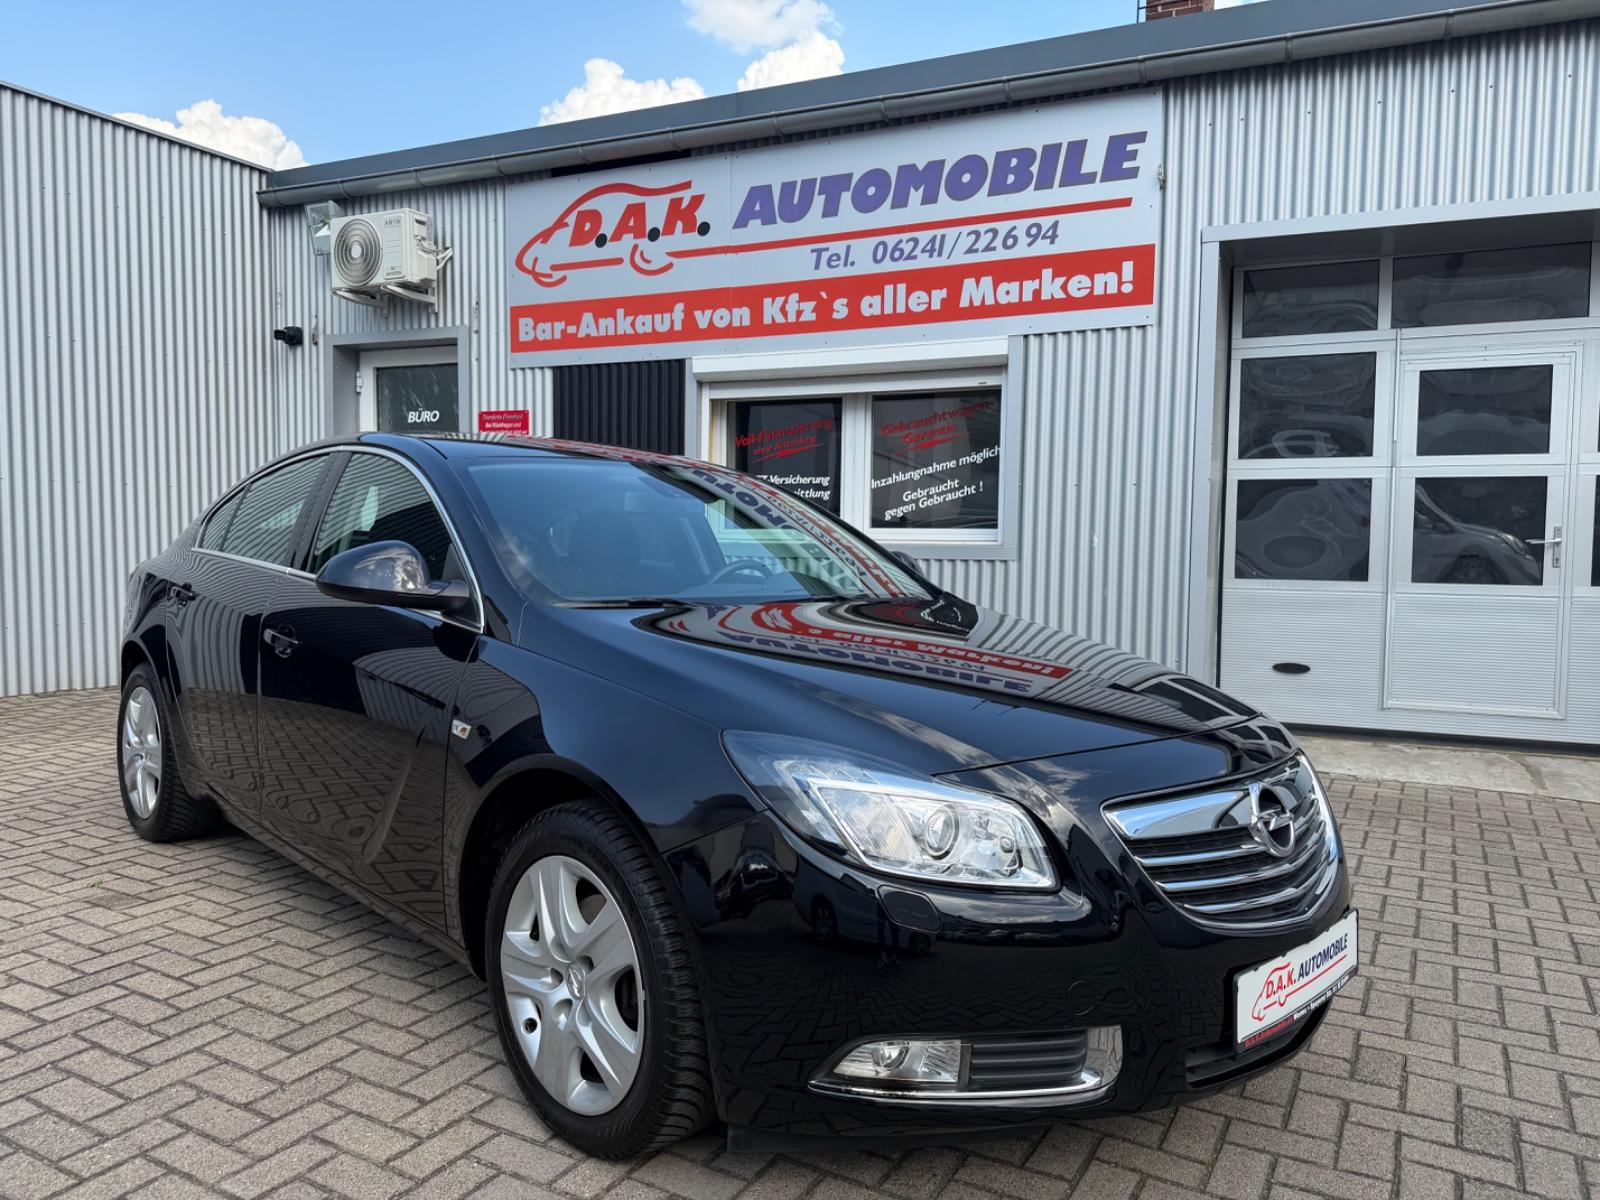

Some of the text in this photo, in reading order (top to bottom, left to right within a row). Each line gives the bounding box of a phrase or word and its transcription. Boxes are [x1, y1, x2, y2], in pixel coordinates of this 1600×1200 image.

[568, 131, 1148, 248] D.A.K. AUTOMOBILE
[811, 245, 856, 271] Tel.
[517, 303, 685, 343] Bar-Ankauf
[694, 306, 750, 330] von
[860, 283, 948, 317] aller
[959, 260, 1135, 309] Marken!
[407, 407, 440, 424] BÜRO
[902, 423, 957, 446] Garantie
[870, 444, 1001, 489] Inzahlungnahme möglich
[793, 487, 832, 501] ittlung
[884, 501, 916, 521] gegen
[918, 484, 977, 509] Gebraucht
[902, 478, 960, 502] Gebraucht
[1265, 967, 1297, 999] D.A.K.
[1297, 932, 1349, 982] AUTOMOBILE
